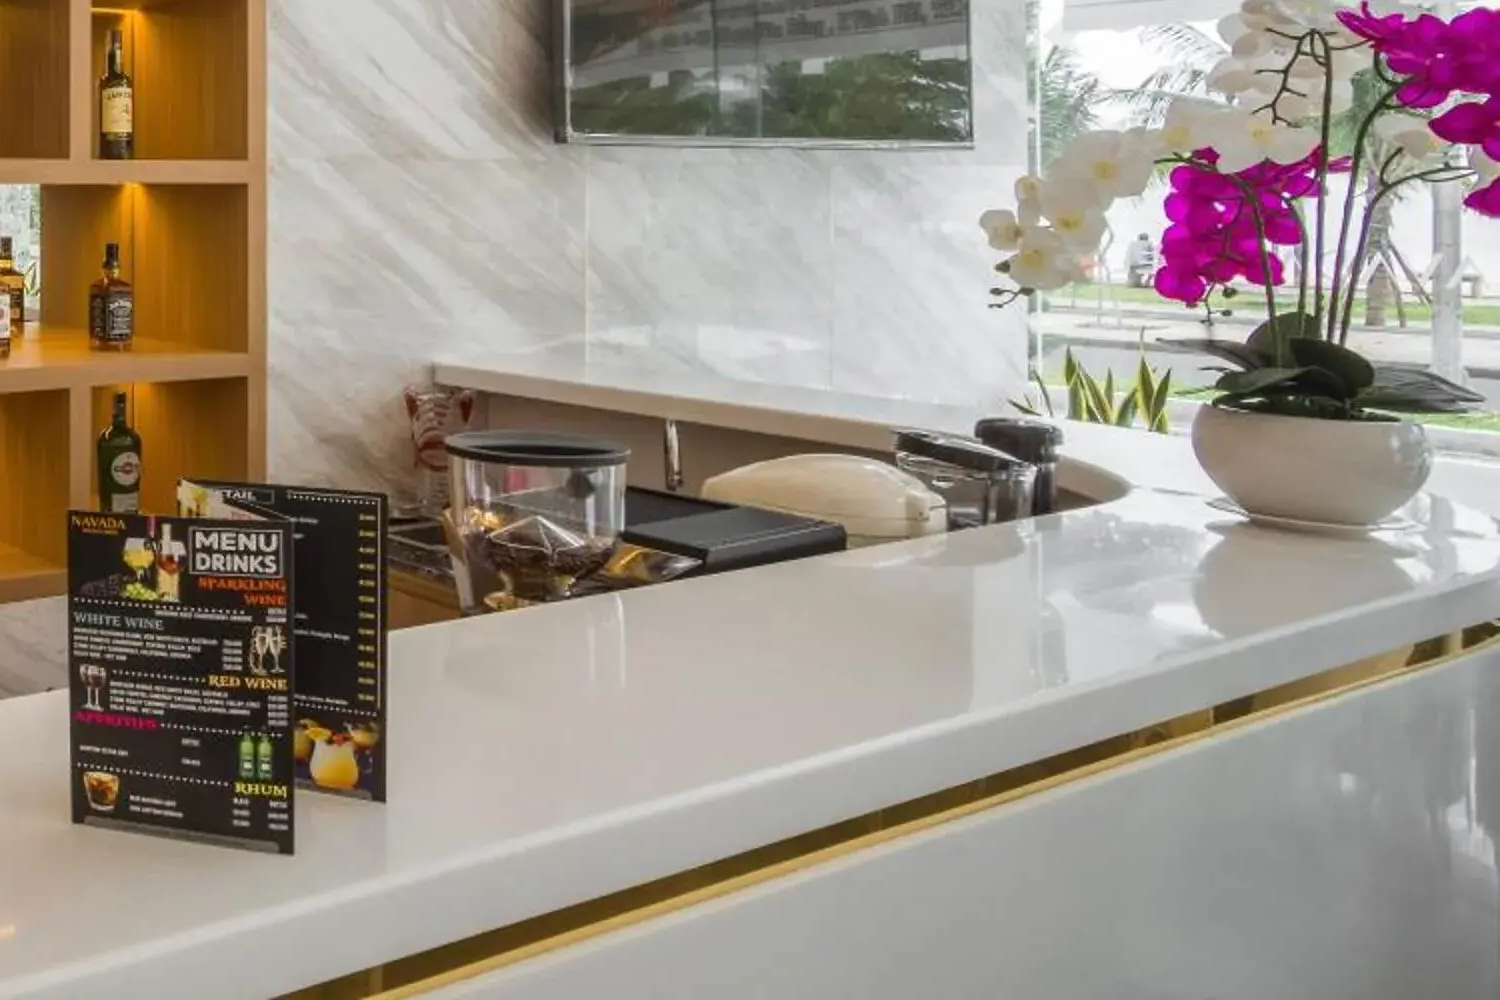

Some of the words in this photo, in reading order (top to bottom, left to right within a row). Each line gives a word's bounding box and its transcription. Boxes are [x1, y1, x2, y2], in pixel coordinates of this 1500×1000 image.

[72, 515, 127, 530] NAVADA
[194, 531, 278, 553] MENU
[195, 554, 277, 574] DRINKS
[244, 594, 288, 607] WINE
[74, 612, 121, 628] WHITE
[125, 616, 165, 632] WINE
[208, 674, 240, 688] RED
[244, 677, 289, 691] WINE
[234, 781, 288, 798] RHUM
